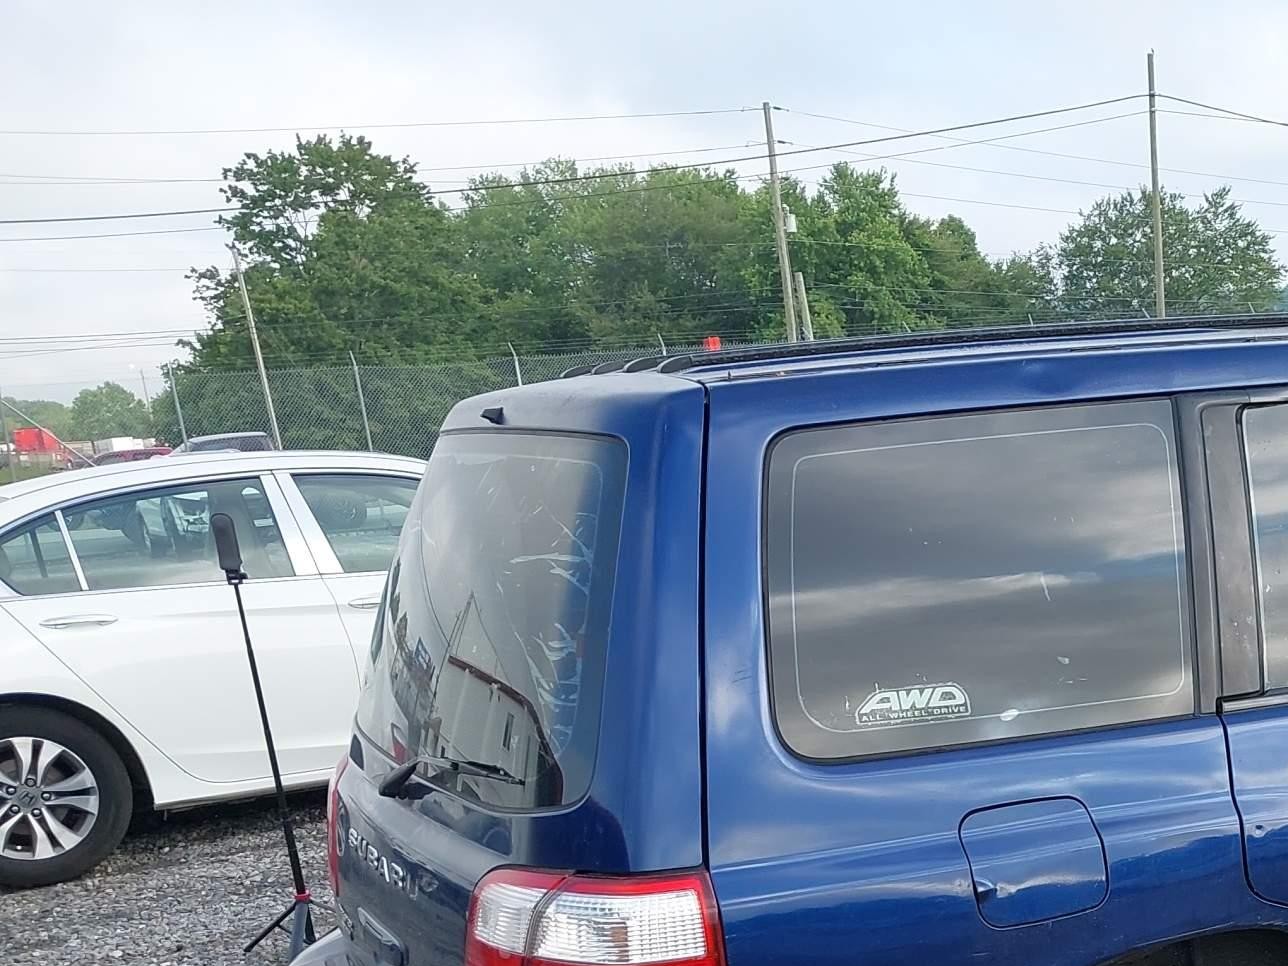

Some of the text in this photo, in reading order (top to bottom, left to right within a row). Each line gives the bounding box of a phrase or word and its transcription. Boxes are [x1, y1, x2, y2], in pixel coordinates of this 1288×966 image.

[859, 686, 966, 714] AWD
[861, 706, 966, 722] ALL WHEEL DRIVE
[347, 827, 419, 901] SUBARU
